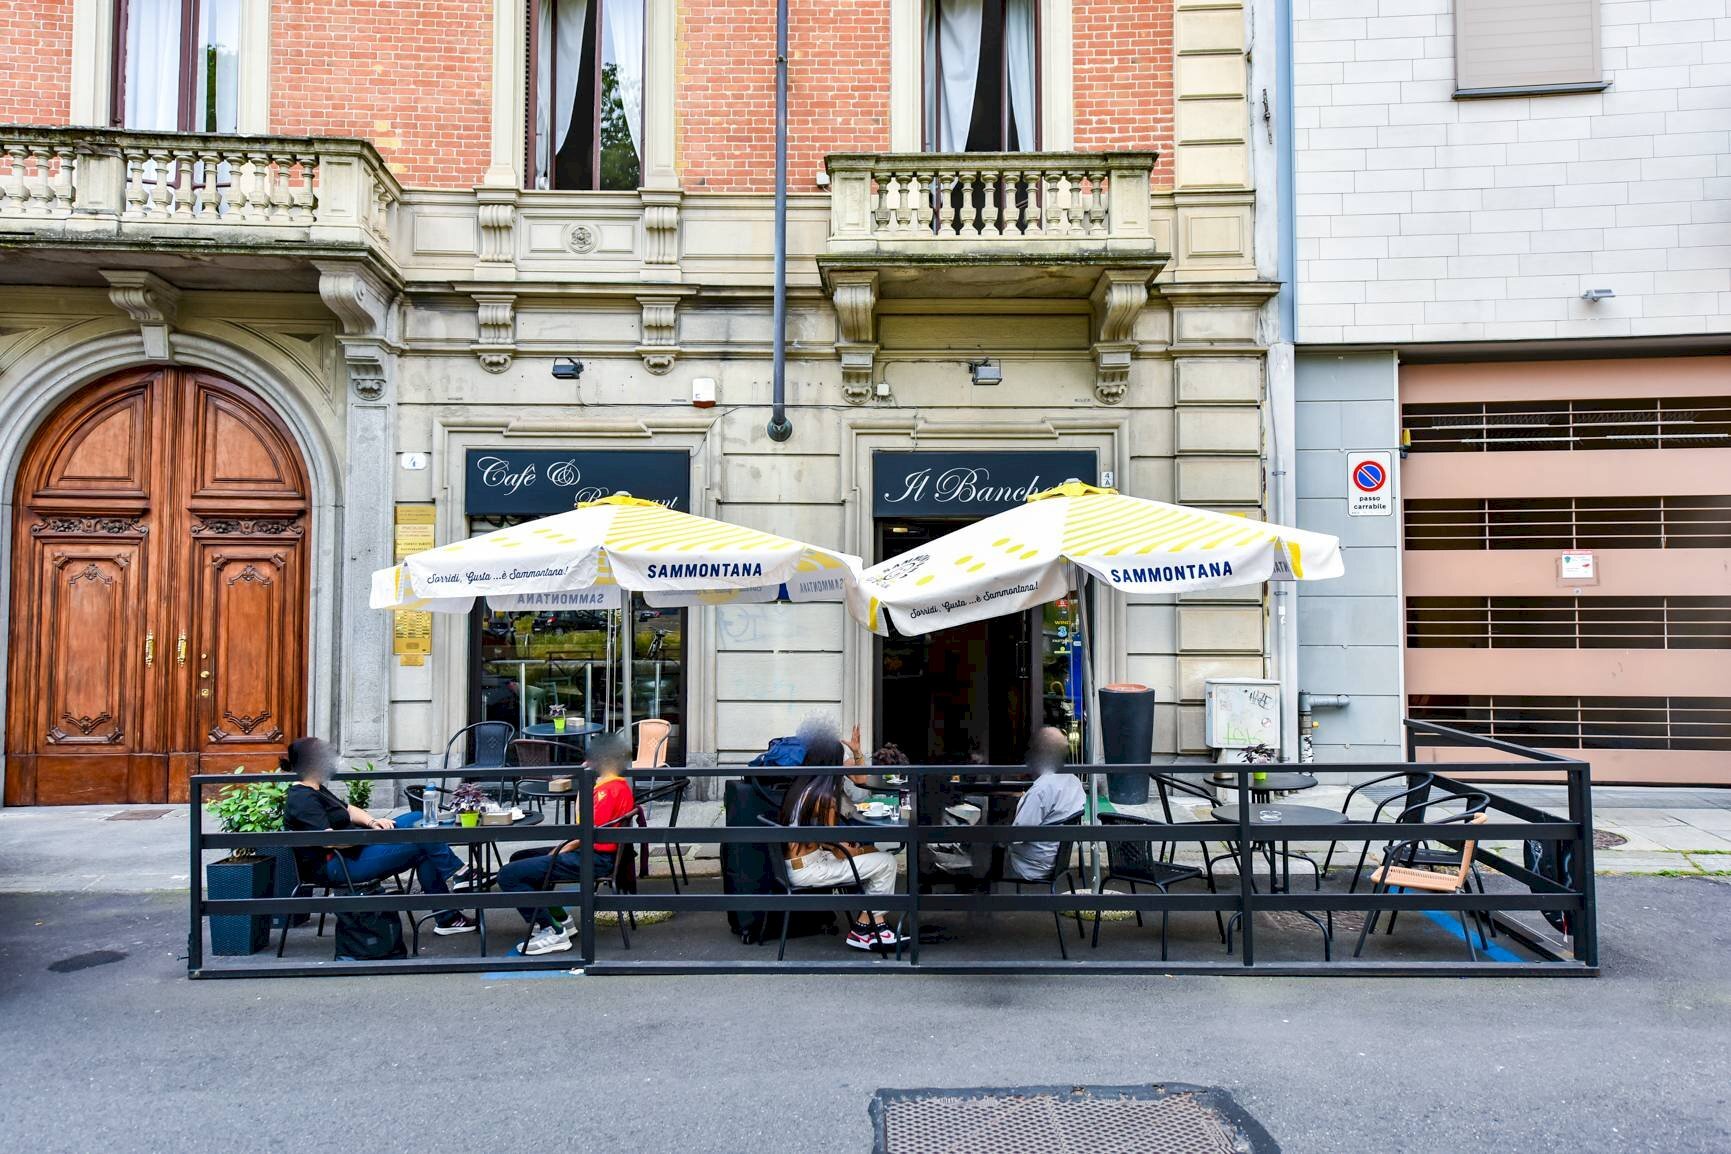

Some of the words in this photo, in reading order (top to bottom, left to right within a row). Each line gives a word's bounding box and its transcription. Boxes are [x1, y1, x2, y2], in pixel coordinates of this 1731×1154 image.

[884, 468, 931, 502] Il
[427, 573, 463, 584] Sorridi,
[466, 571, 491, 585] Gusta
[509, 566, 569, 580] Sammontana!
[647, 562, 763, 579] SAMMONTANA
[1110, 560, 1233, 583] SAMMONTANA
[942, 599, 967, 613] Gusta
[982, 581, 1039, 601] Sammontana!
